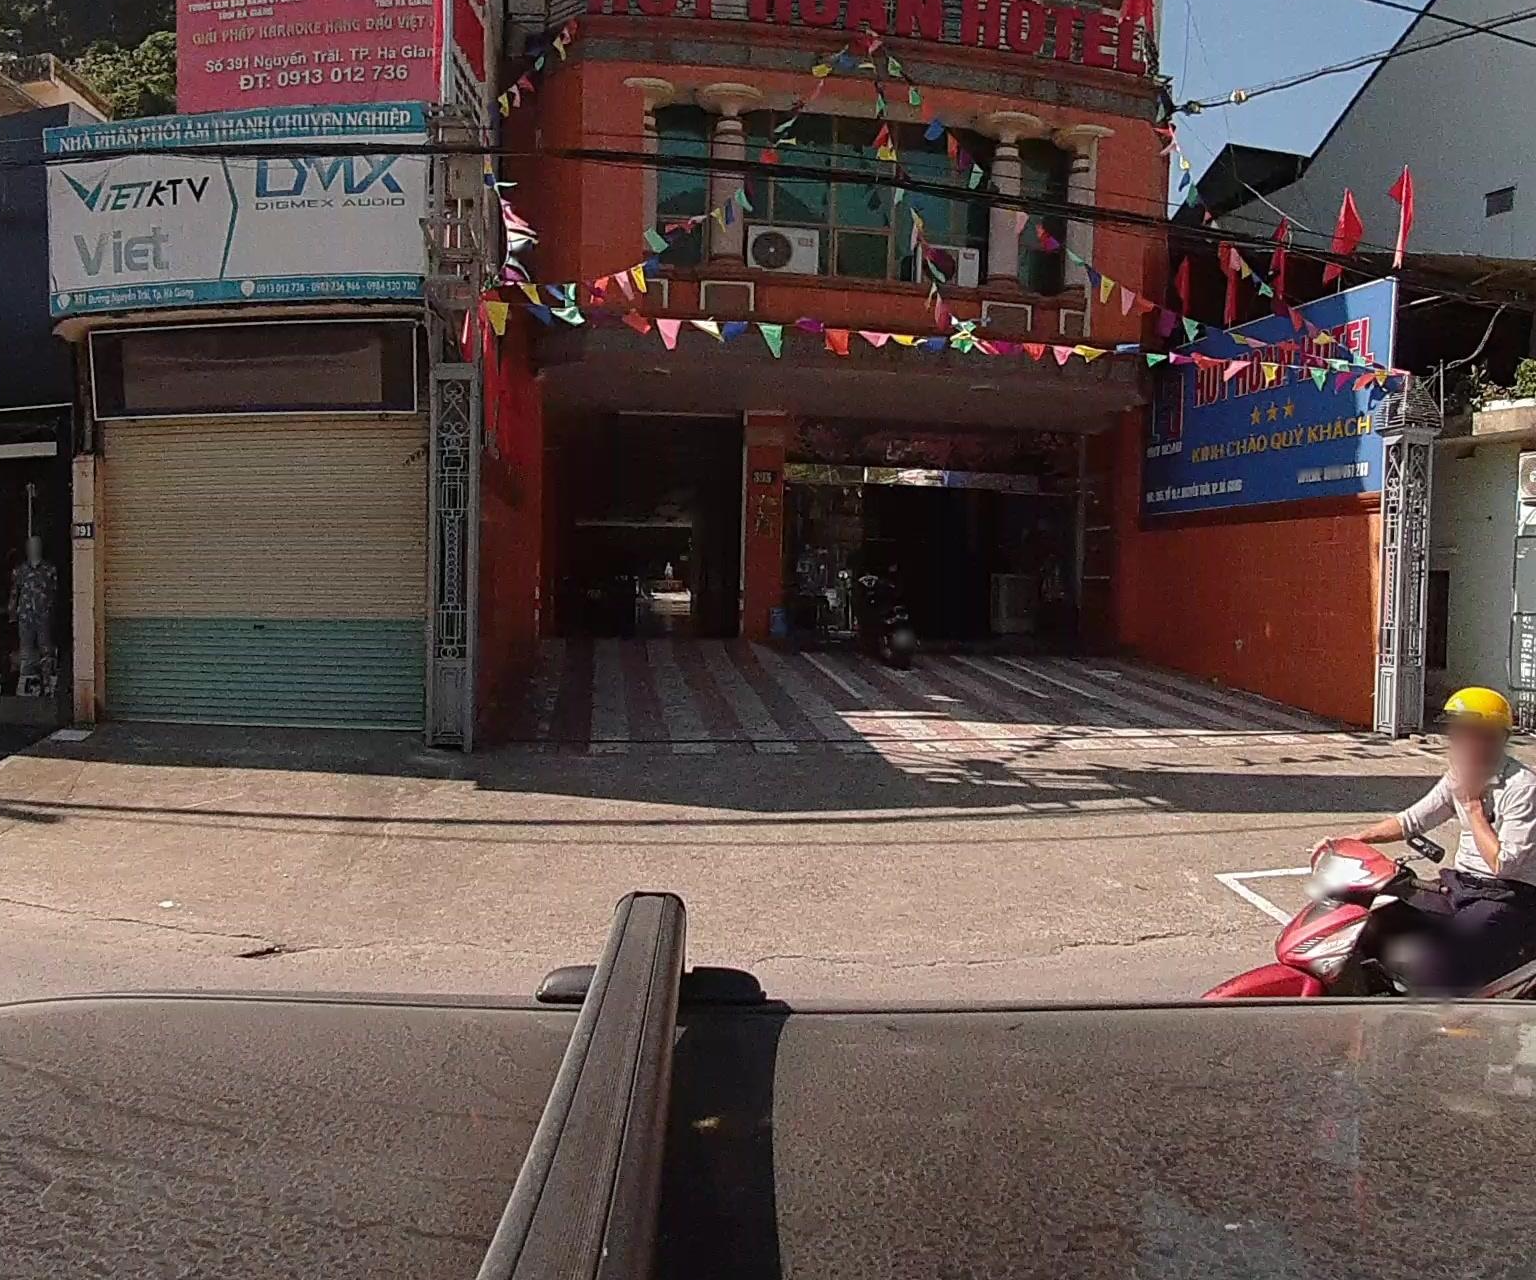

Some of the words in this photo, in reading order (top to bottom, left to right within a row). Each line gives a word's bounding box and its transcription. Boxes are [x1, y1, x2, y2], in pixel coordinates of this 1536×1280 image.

[259, 20, 321, 40] KARAOKE
[205, 57, 224, 74] Số
[226, 55, 250, 70] 391
[349, 47, 372, 62] TP.
[239, 73, 272, 91] ĐT:
[277, 70, 323, 88] 0913
[330, 67, 365, 83] 012
[371, 64, 409, 81] 736
[73, 226, 170, 277] Viet
[342, 197, 405, 207] AUDIO
[1227, 433, 1267, 457] CHÀO
[1307, 414, 1373, 444] KHÁCH
